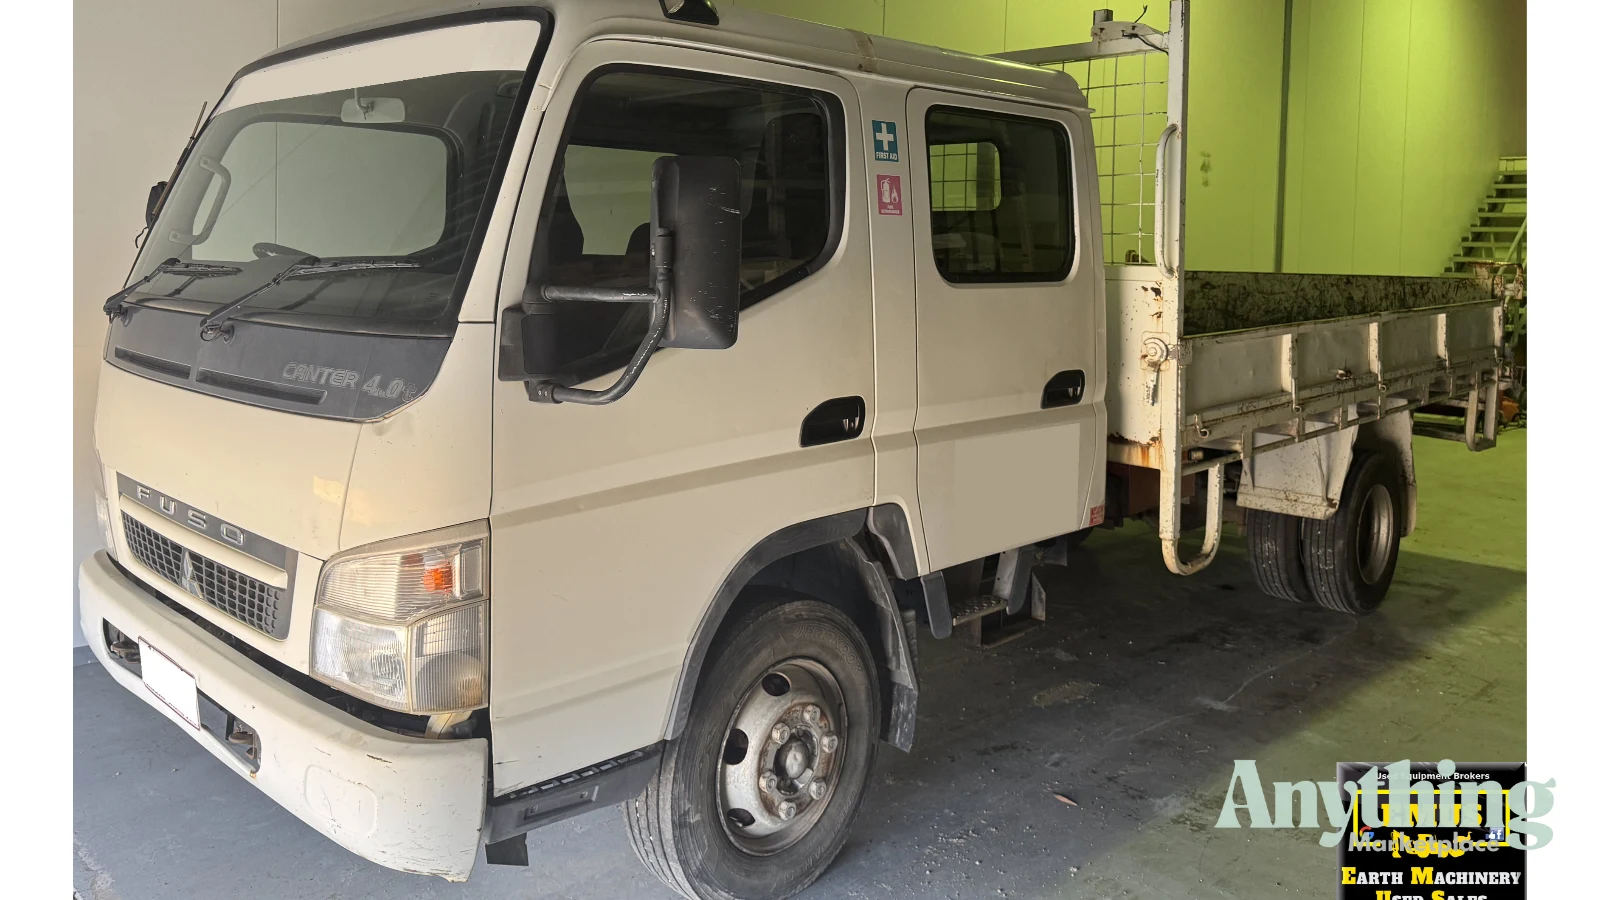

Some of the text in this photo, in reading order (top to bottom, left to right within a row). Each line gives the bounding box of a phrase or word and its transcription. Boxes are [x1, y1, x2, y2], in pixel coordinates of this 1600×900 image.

[876, 152, 889, 160] FIRST
[282, 361, 360, 389] CANTER
[136, 483, 246, 546] FUSO
